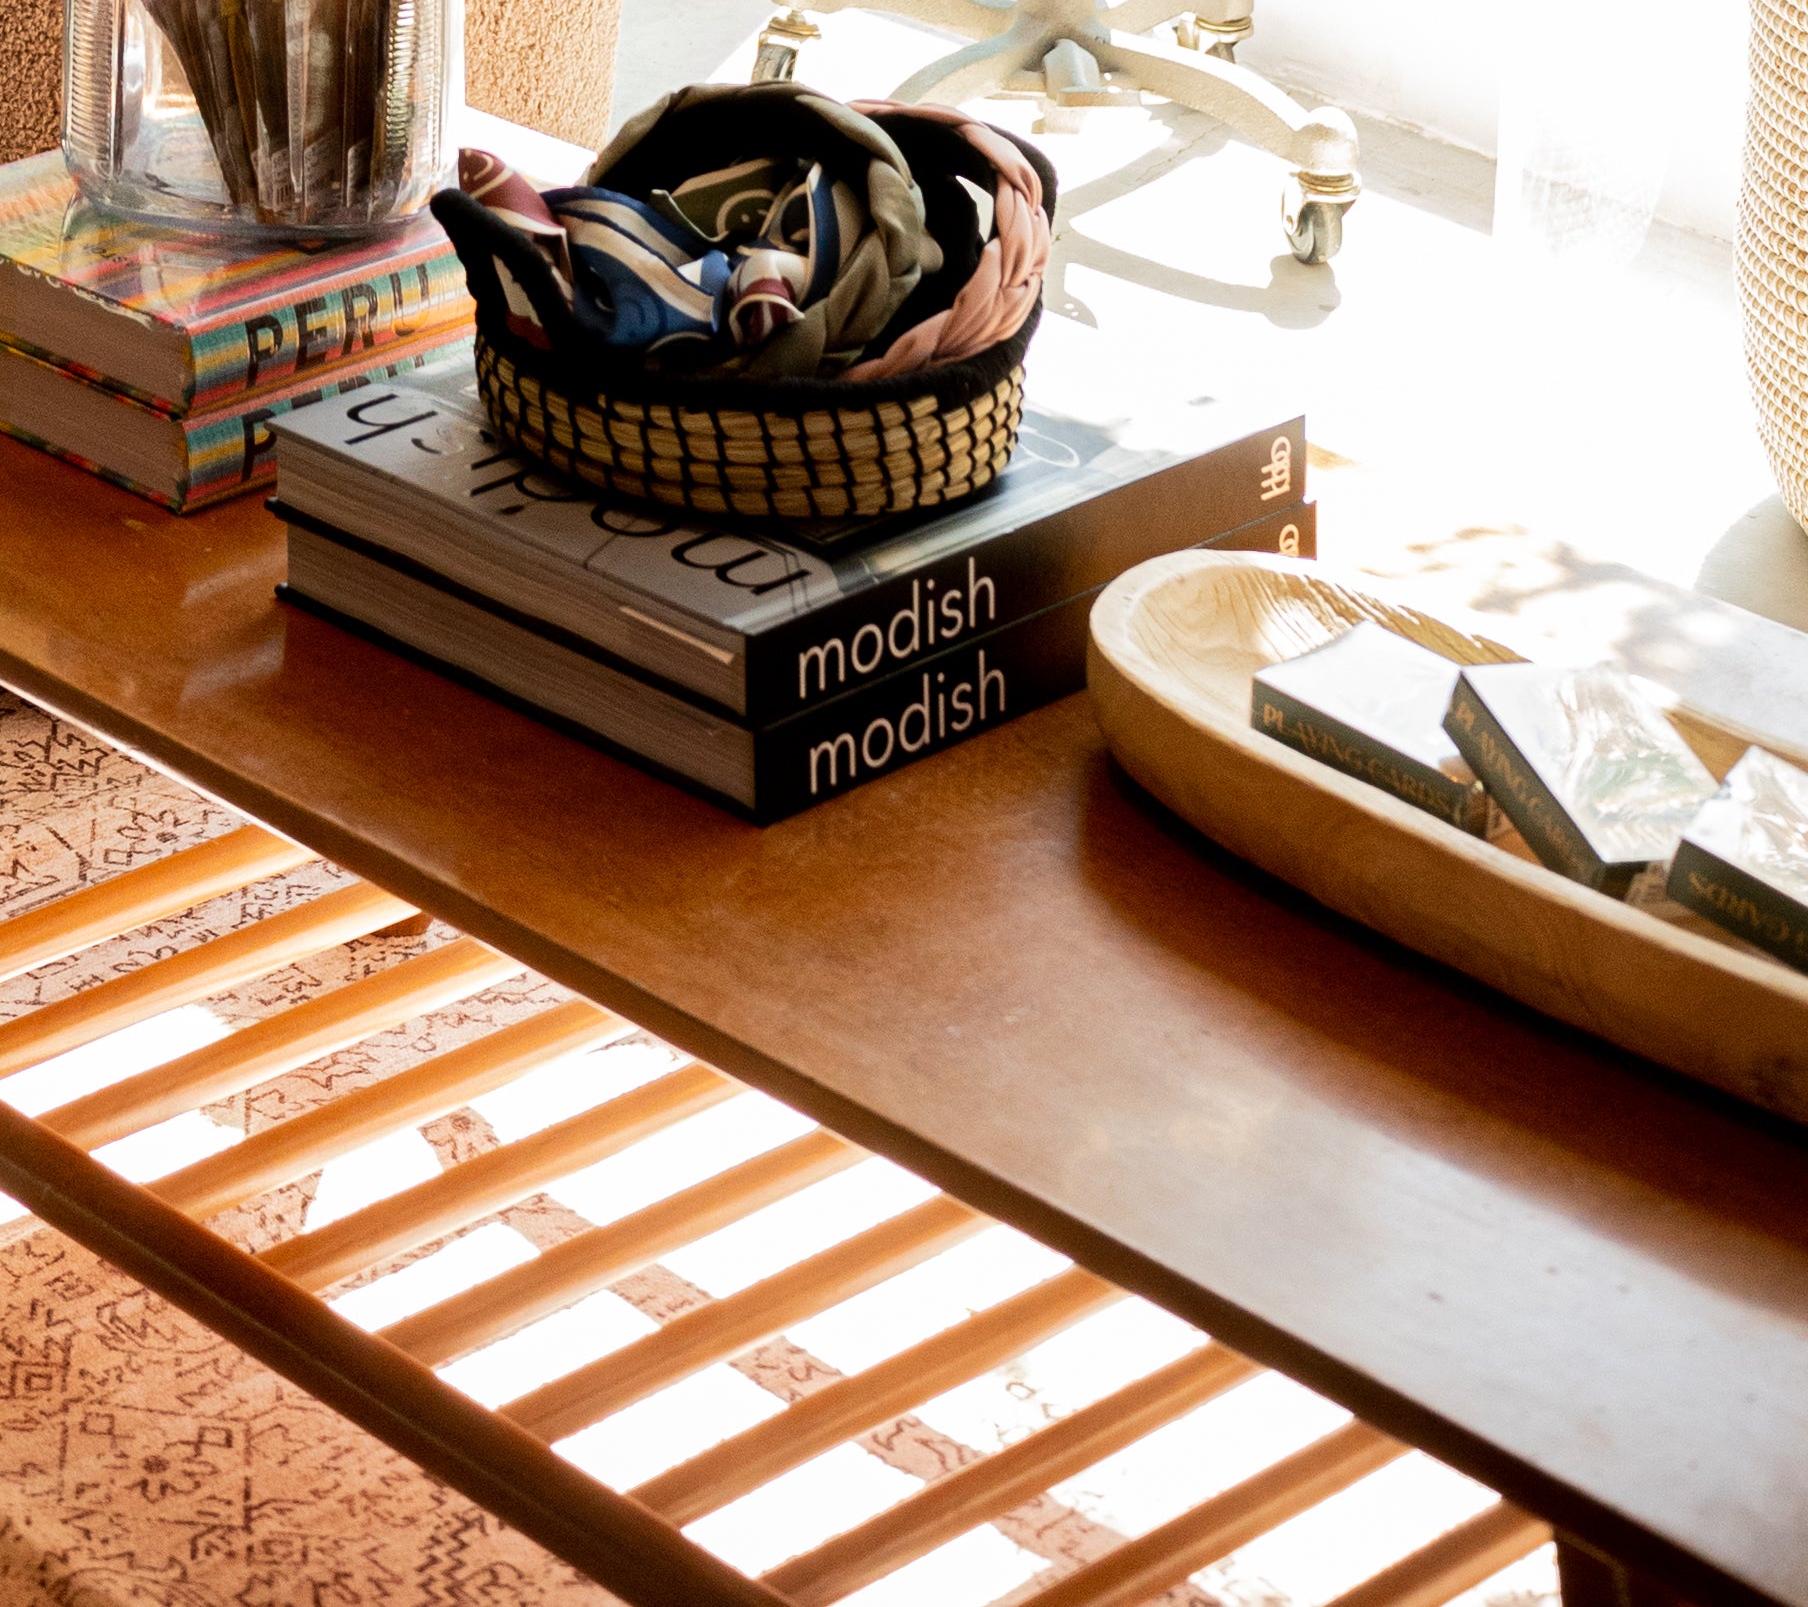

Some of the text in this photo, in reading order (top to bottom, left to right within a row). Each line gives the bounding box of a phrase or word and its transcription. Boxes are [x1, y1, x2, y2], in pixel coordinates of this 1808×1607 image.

[244, 263, 431, 388] PERU
[799, 556, 996, 699] modish
[810, 649, 1006, 794] modish
